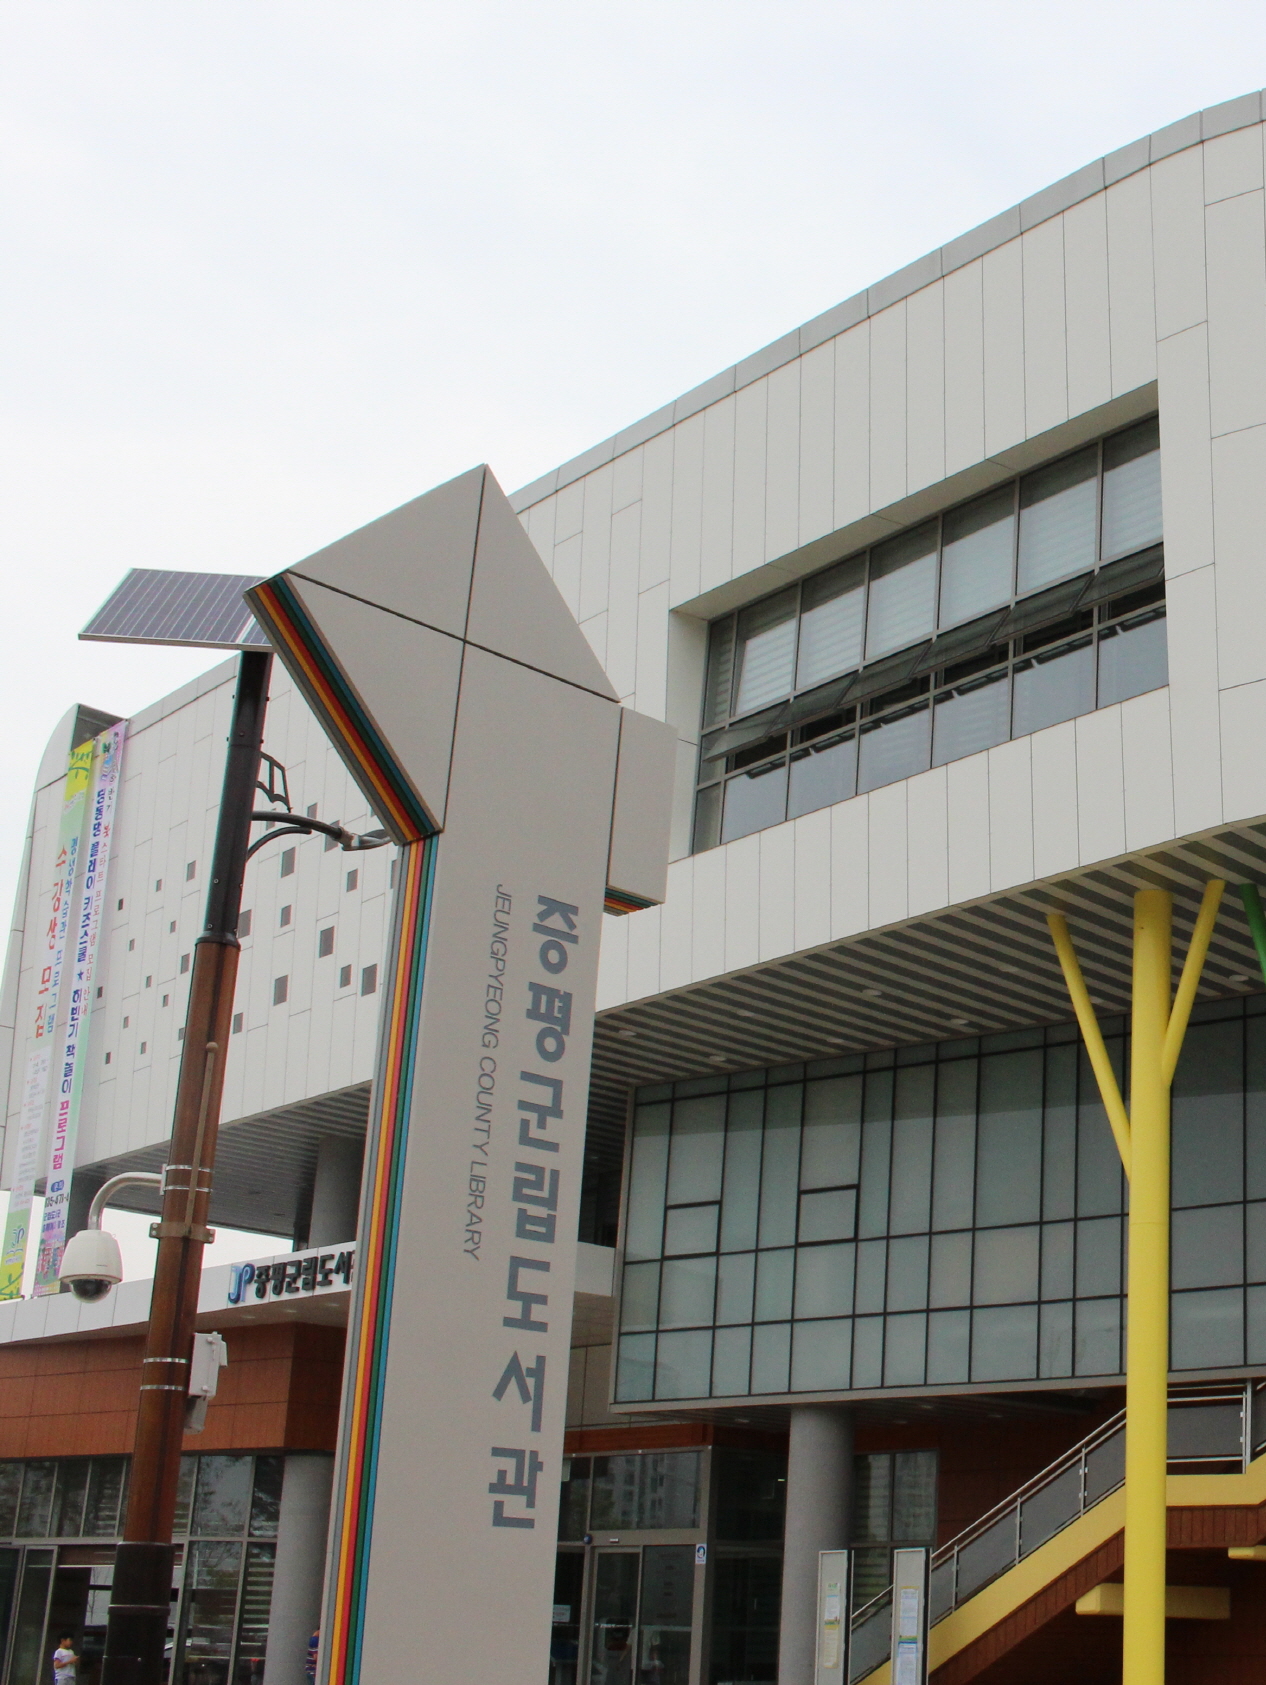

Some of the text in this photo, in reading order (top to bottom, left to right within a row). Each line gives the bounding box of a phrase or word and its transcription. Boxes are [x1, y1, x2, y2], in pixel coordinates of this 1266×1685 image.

[35, 844, 68, 1039] 수강생 모집
[89, 890, 102, 947] 프로그램
[47, 949, 64, 1034] 프로그램
[463, 884, 513, 1261] JEUNGPYEONG COUNTY LIBRARY
[53, 1100, 70, 1170] 프로그램
[488, 893, 580, 1530] 증평군립도서관
[254, 1250, 356, 1299] 증평군립도서
